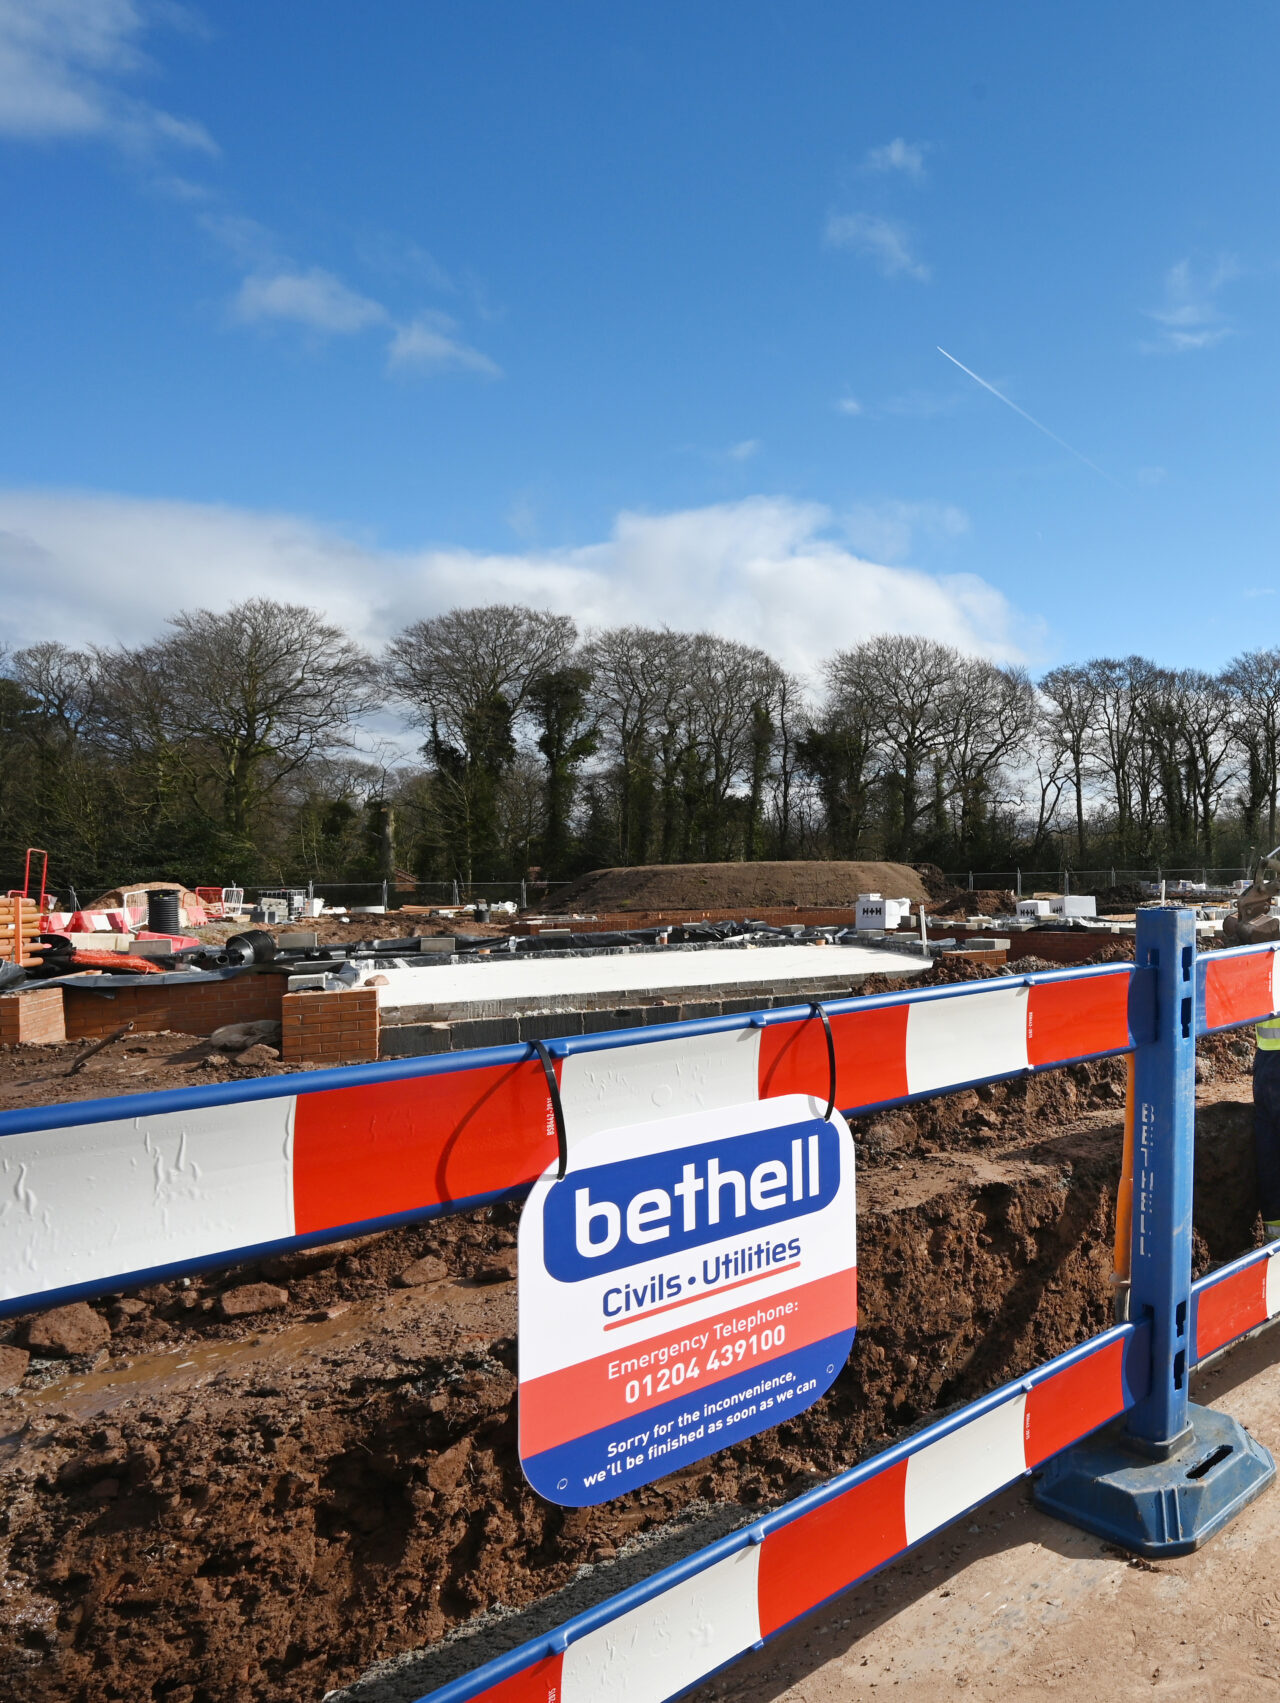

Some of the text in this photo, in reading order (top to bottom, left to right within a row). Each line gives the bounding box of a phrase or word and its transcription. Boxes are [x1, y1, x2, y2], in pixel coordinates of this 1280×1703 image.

[862, 907, 882, 916] H+H
[575, 1134, 820, 1259] bethell
[602, 1237, 801, 1317] Civils Utilities
[608, 1300, 799, 1380] Emergency Telephone:
[625, 1324, 787, 1404] 01204 439100
[607, 1371, 797, 1459] Sorry for the inconvenience,
[626, 1453, 645, 1470] be
[647, 1424, 705, 1460] finished
[707, 1420, 724, 1434] as
[726, 1405, 757, 1426] soon
[759, 1398, 774, 1411] as
[775, 1388, 794, 1404] we
[796, 1378, 817, 1395] can
